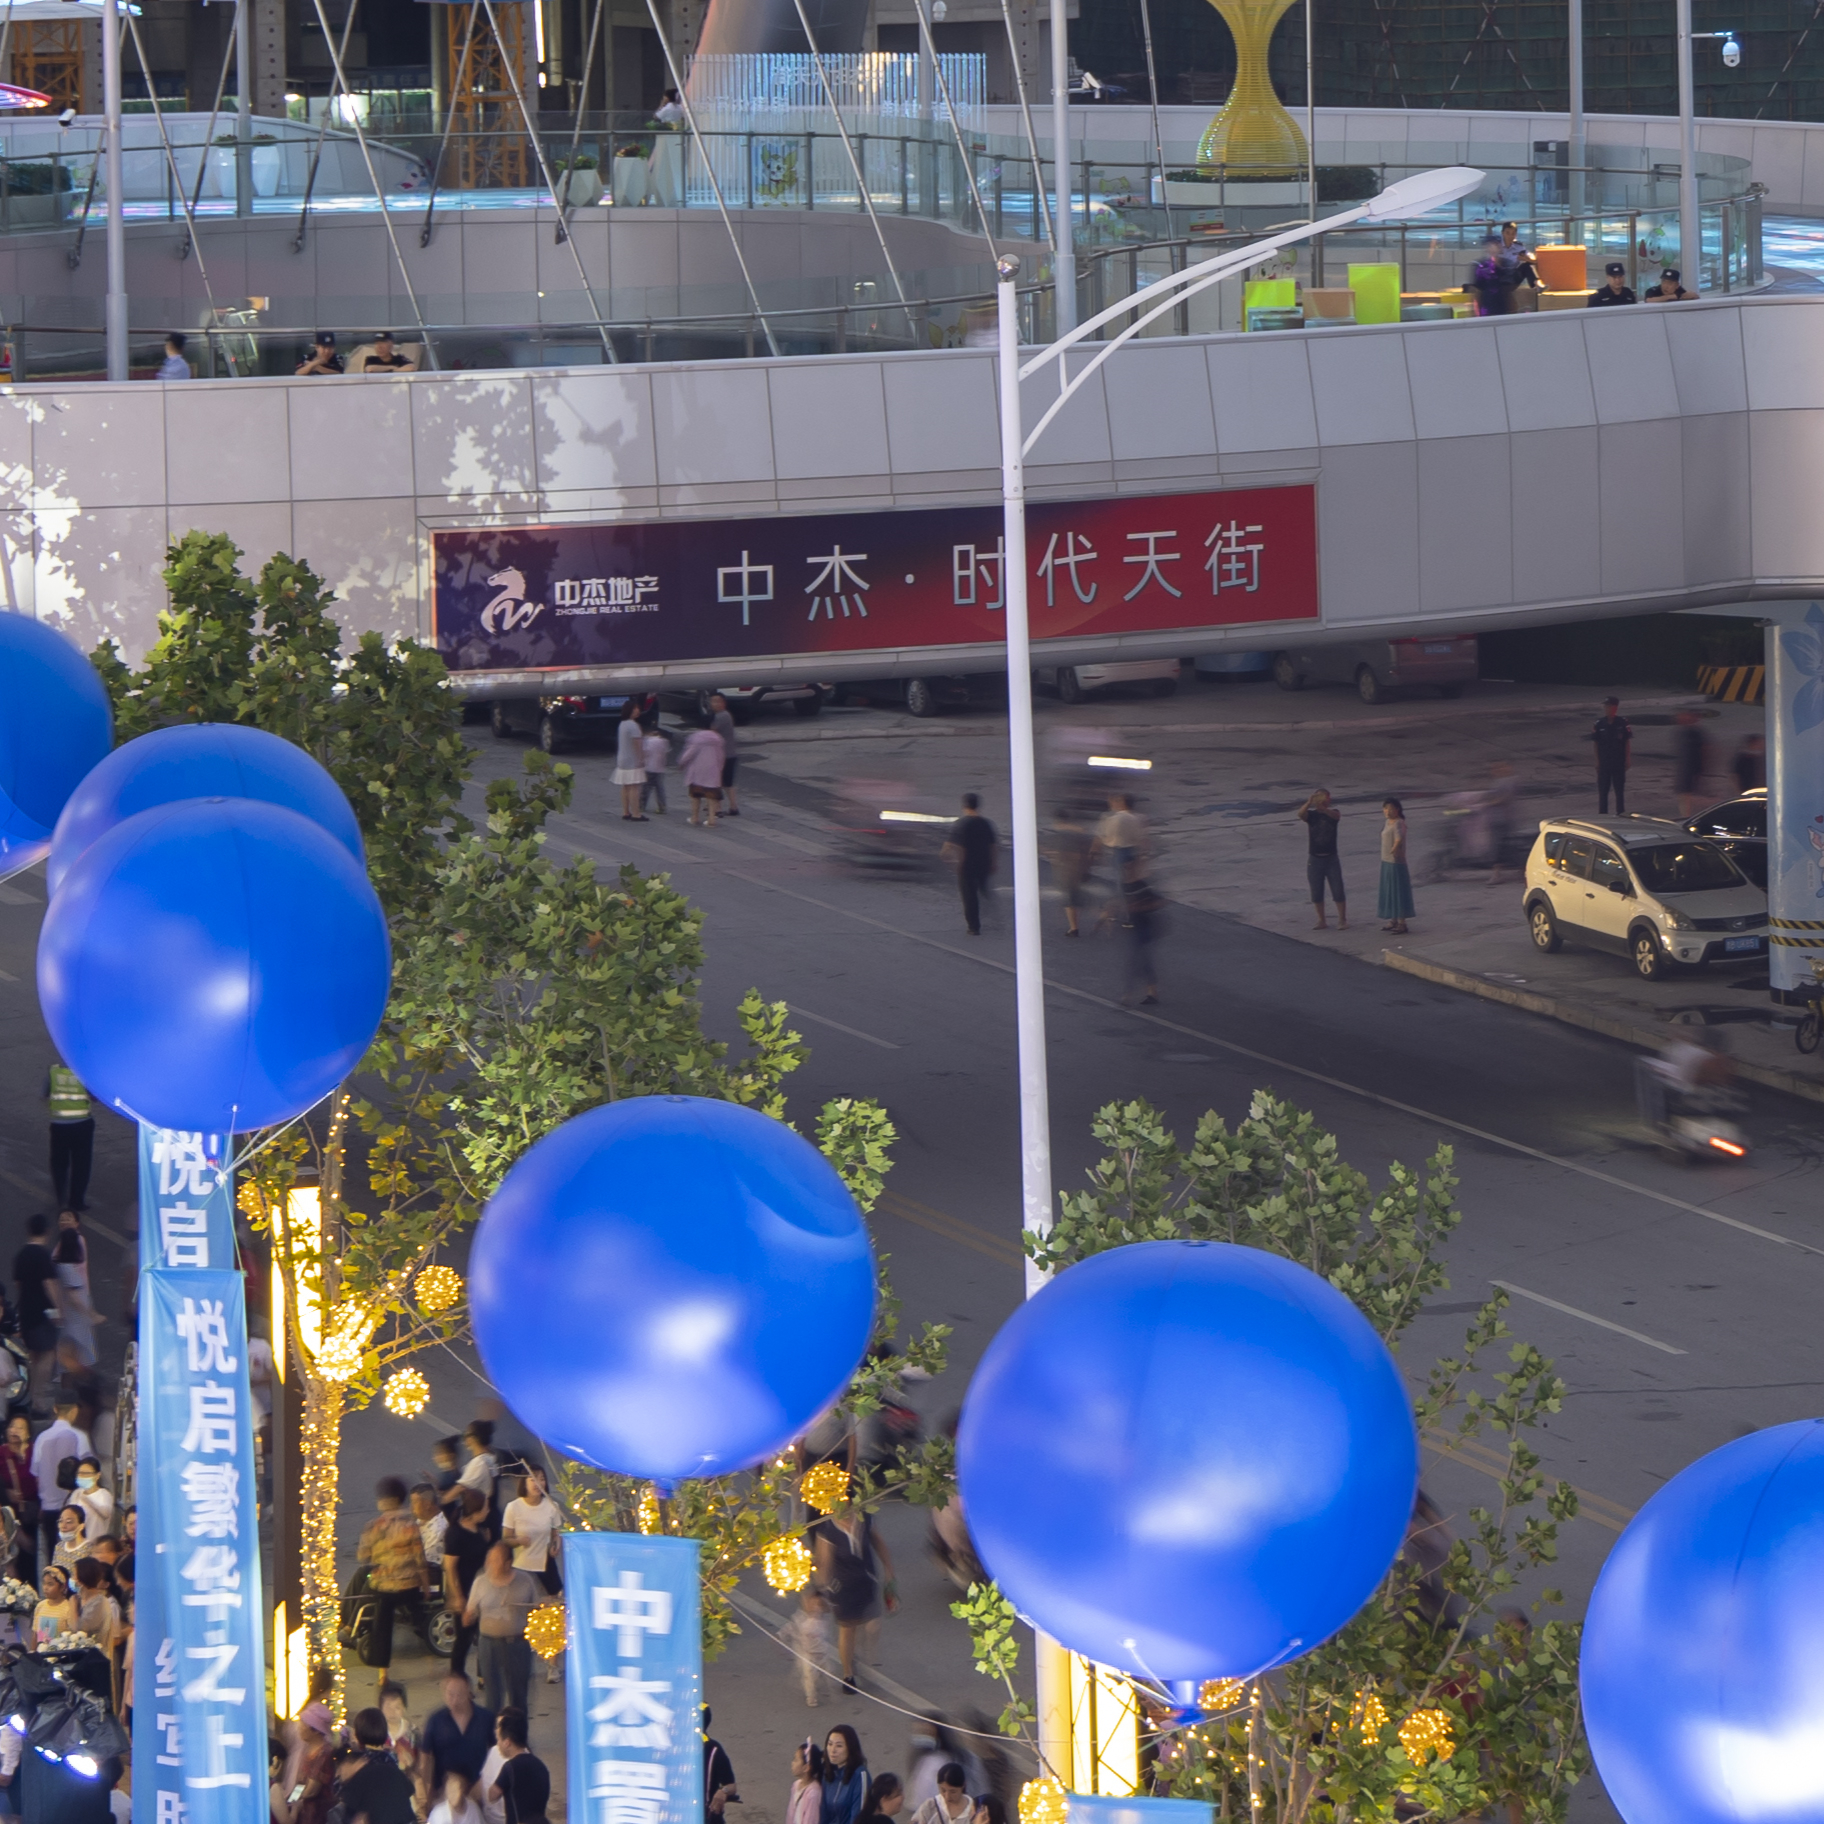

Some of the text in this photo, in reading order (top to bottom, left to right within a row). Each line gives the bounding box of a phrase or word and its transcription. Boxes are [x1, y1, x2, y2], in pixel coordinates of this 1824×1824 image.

[554, 575, 660, 607] 中杰地产
[554, 604, 659, 617] ZHONGJIE REAL ESTATE
[177, 1297, 251, 1789] 悦启繁华之上
